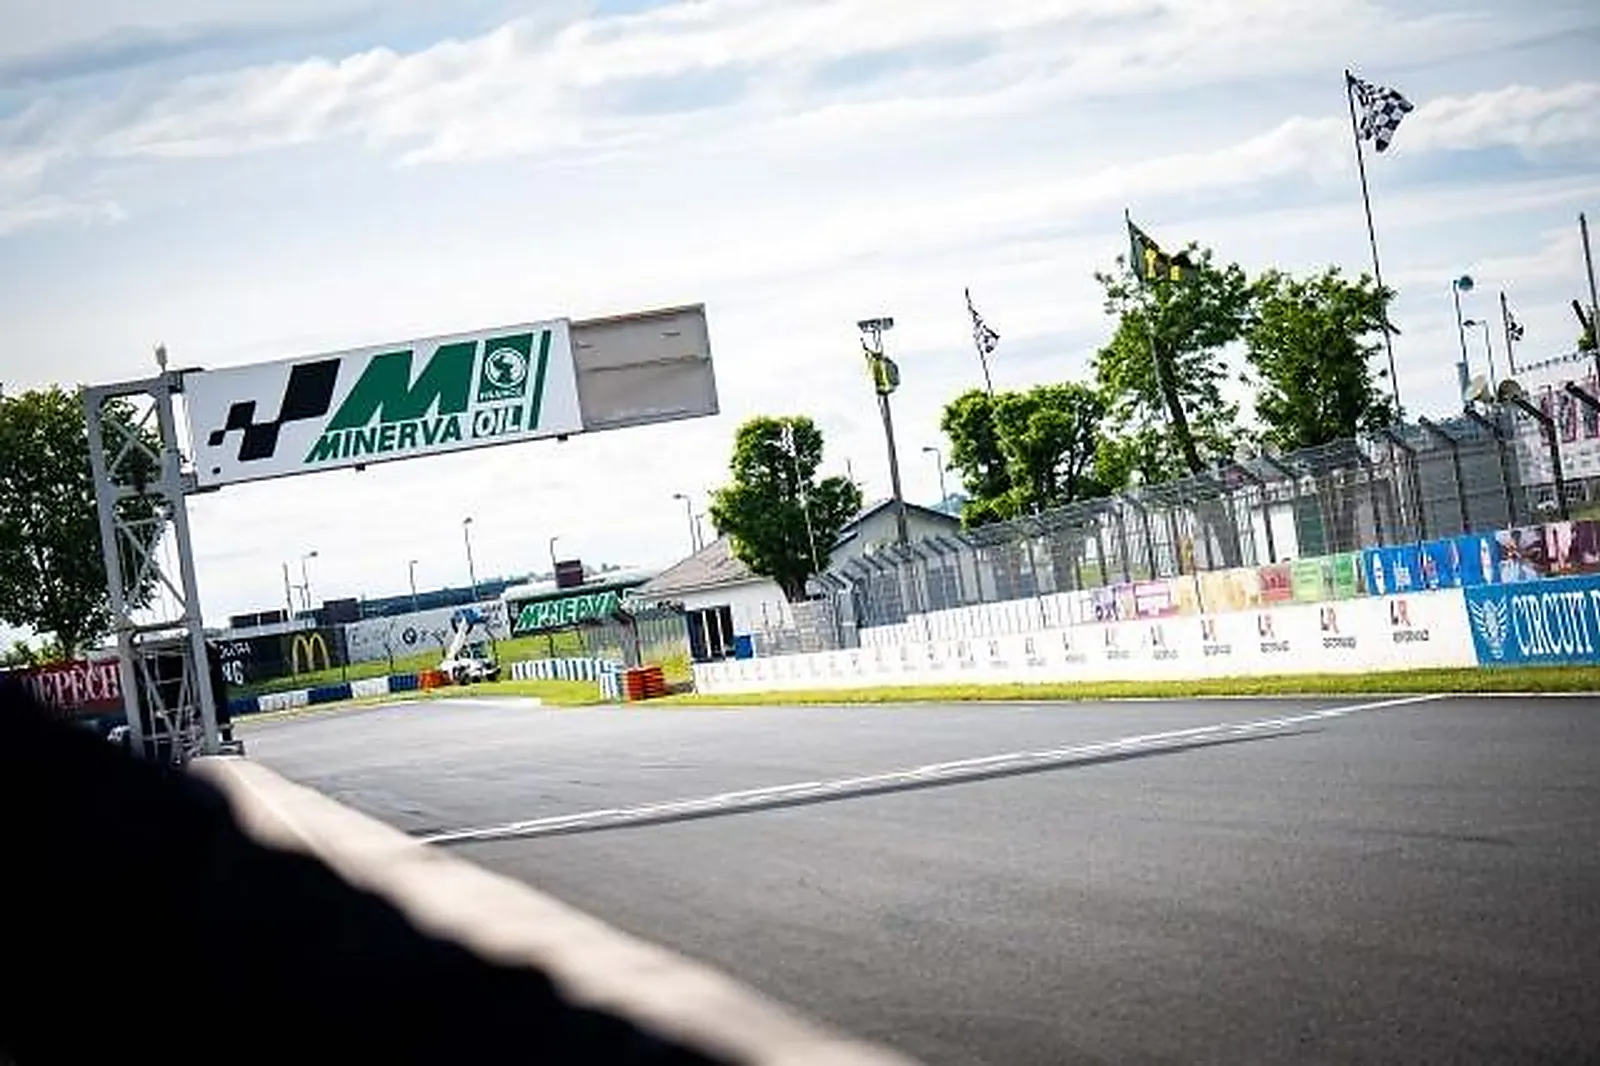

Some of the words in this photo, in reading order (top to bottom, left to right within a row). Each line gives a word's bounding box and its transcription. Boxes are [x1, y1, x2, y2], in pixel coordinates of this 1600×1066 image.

[303, 413, 462, 463] MINERVA
[475, 404, 523, 437] OIL
[1511, 590, 1593, 656] CIRCUIT
